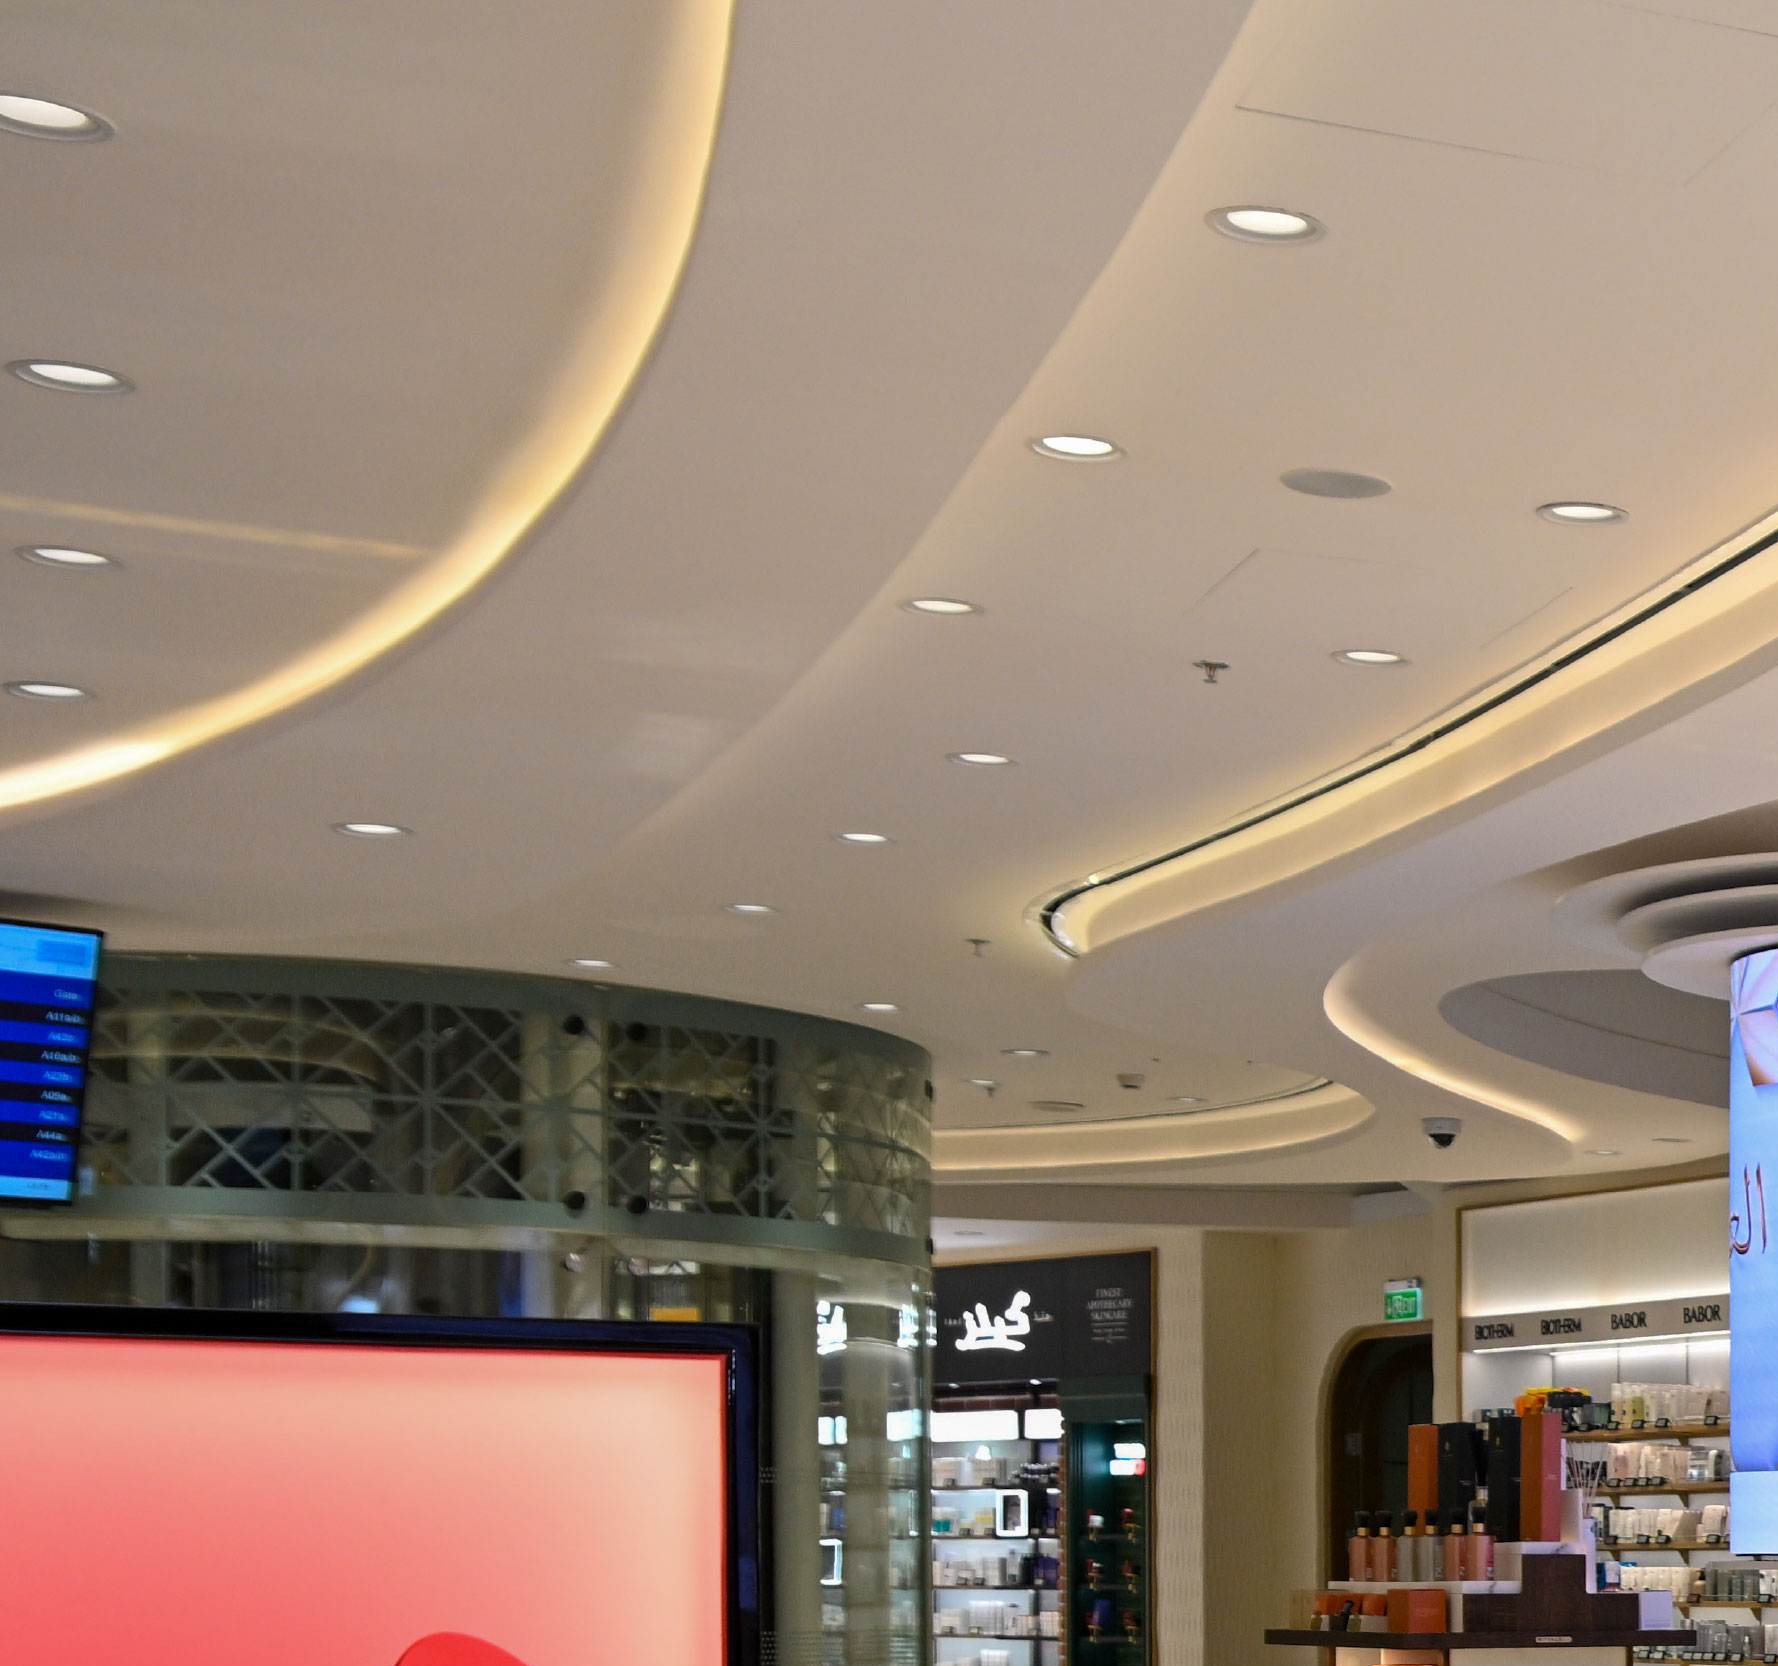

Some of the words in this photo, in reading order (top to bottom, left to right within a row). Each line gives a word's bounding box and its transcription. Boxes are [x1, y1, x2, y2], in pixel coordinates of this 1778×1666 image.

[1611, 1311, 1648, 1330] BABOR
[1683, 1304, 1722, 1324] BABOR
[1474, 1324, 1515, 1341] BIOTHERM
[1540, 1318, 1582, 1336] BIOTHERM
